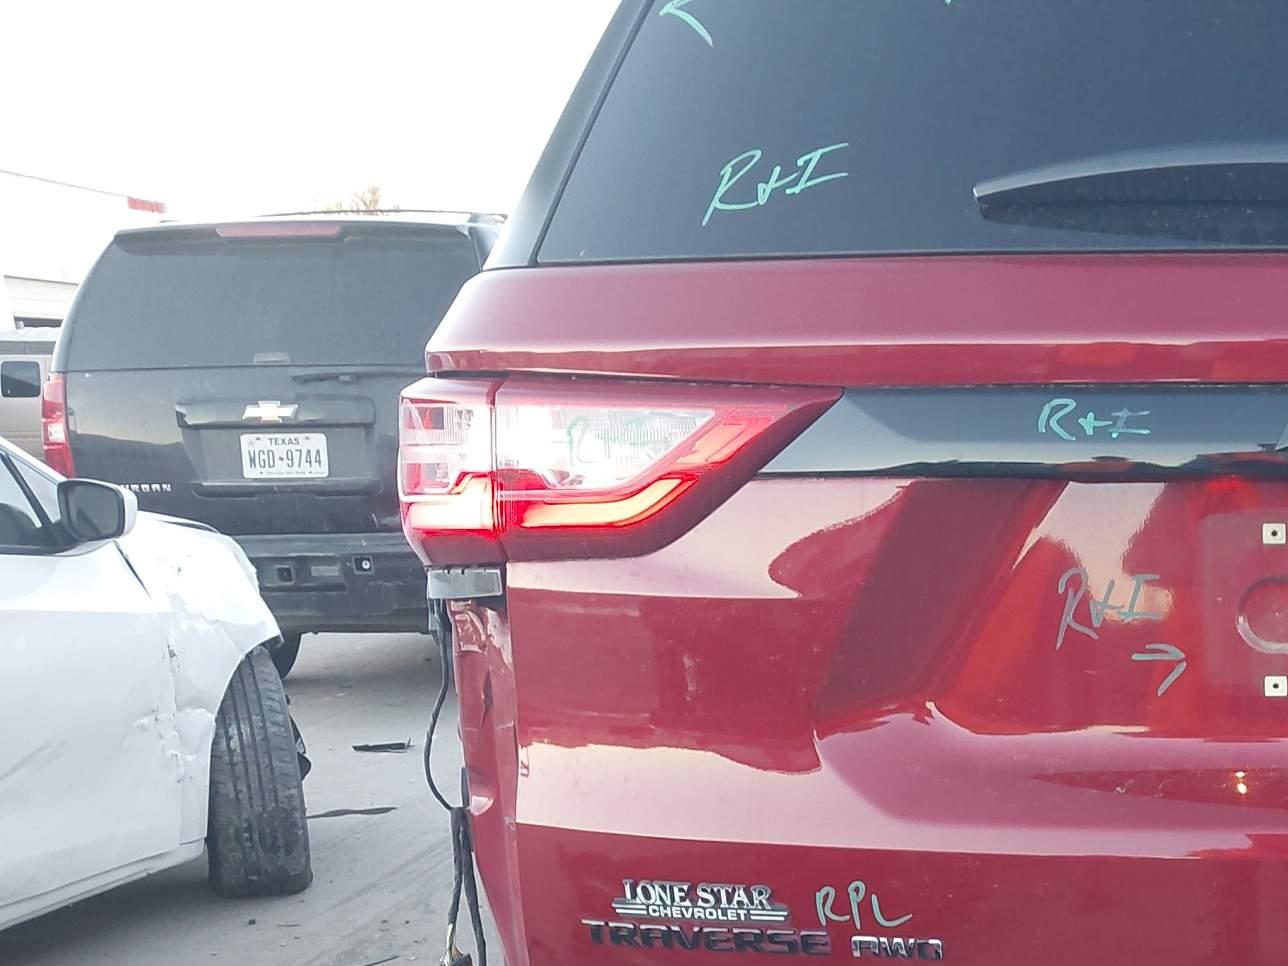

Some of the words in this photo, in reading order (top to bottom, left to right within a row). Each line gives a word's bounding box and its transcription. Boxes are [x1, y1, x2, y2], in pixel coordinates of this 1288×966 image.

[268, 437, 300, 446] TEXAS
[623, 880, 691, 907] LONE
[696, 883, 772, 910] STAR
[815, 880, 913, 930] RPL
[648, 905, 748, 921] CHEVROLET
[581, 919, 831, 956] TRAVERSE
[851, 935, 943, 960] AWD
